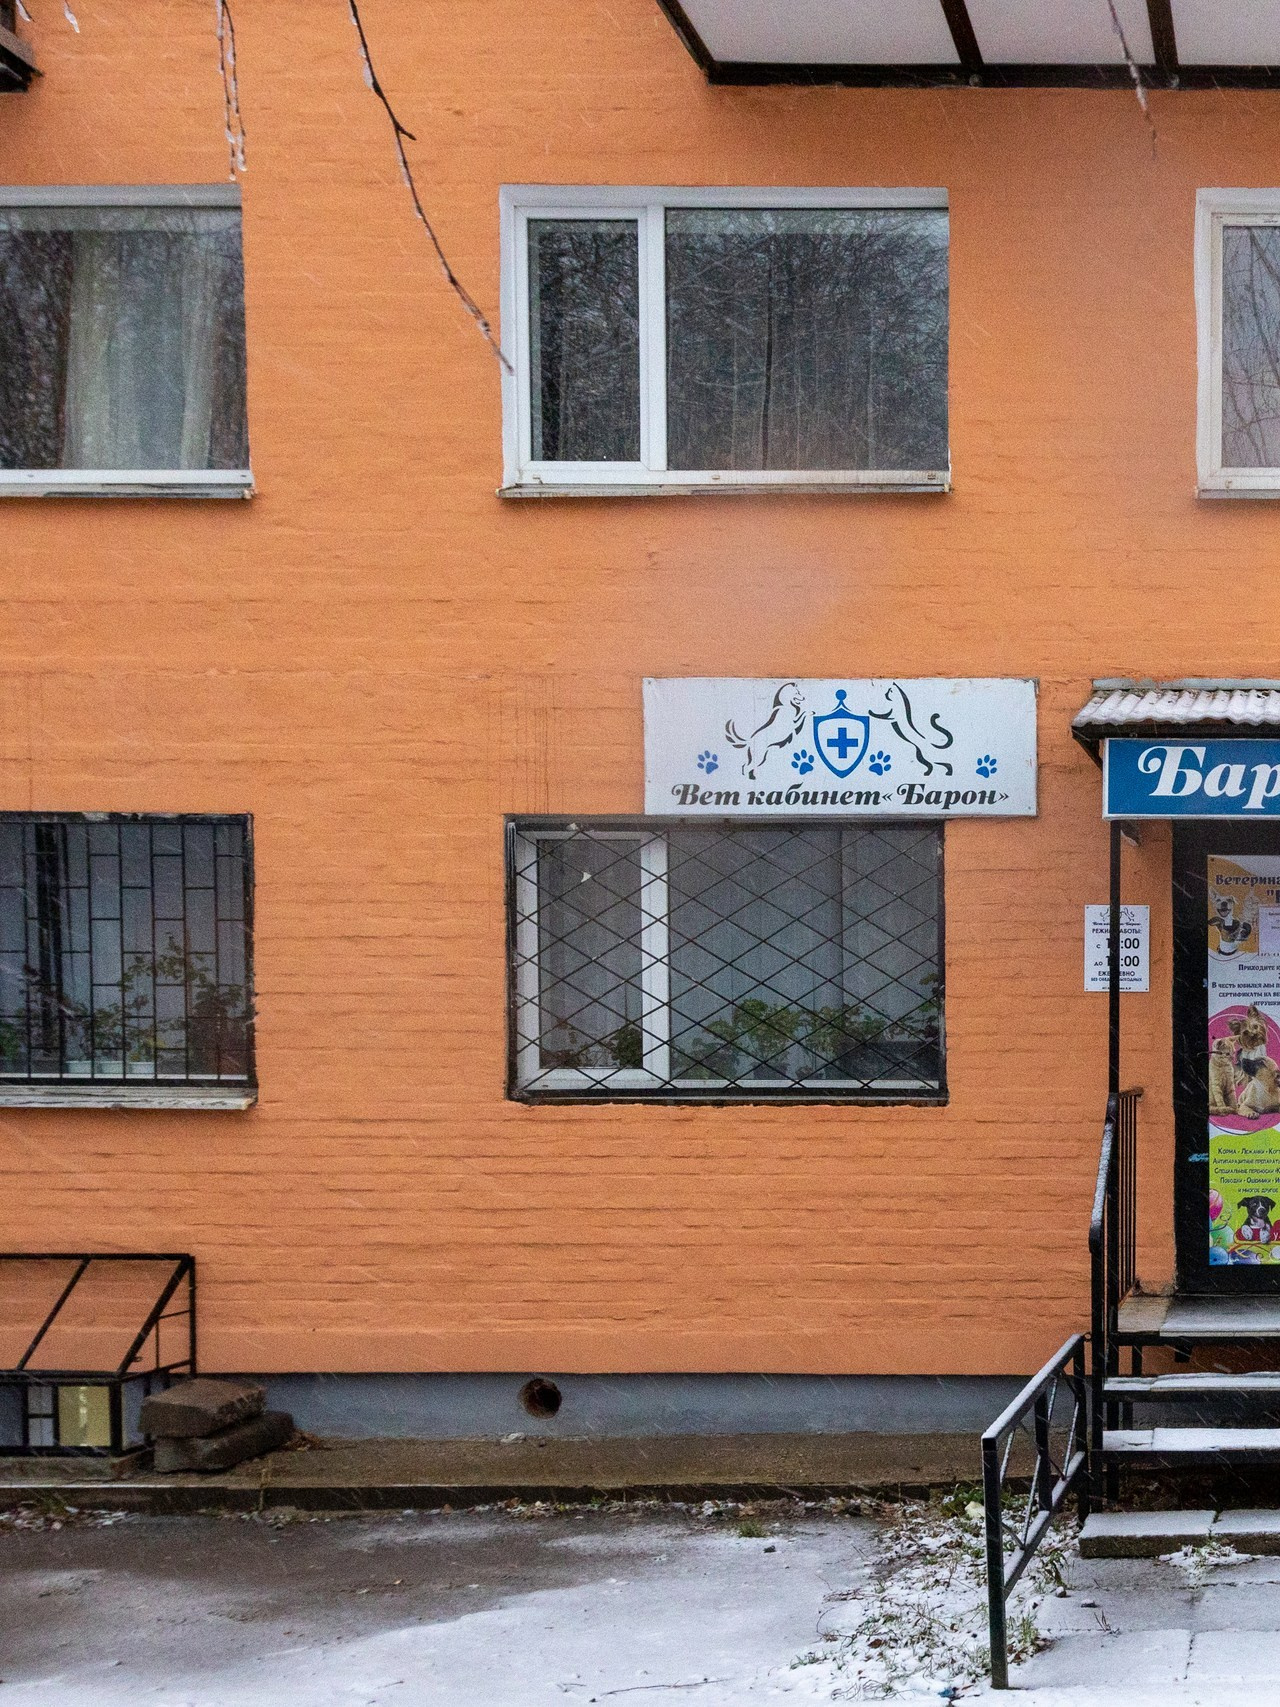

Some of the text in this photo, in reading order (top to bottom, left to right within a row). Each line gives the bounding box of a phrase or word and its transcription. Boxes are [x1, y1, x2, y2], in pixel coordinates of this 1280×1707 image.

[671, 783, 741, 805] Вет
[747, 782, 881, 806] кабинет
[1106, 938, 1140, 949] 1:00
[1106, 955, 1140, 967] 1:00
